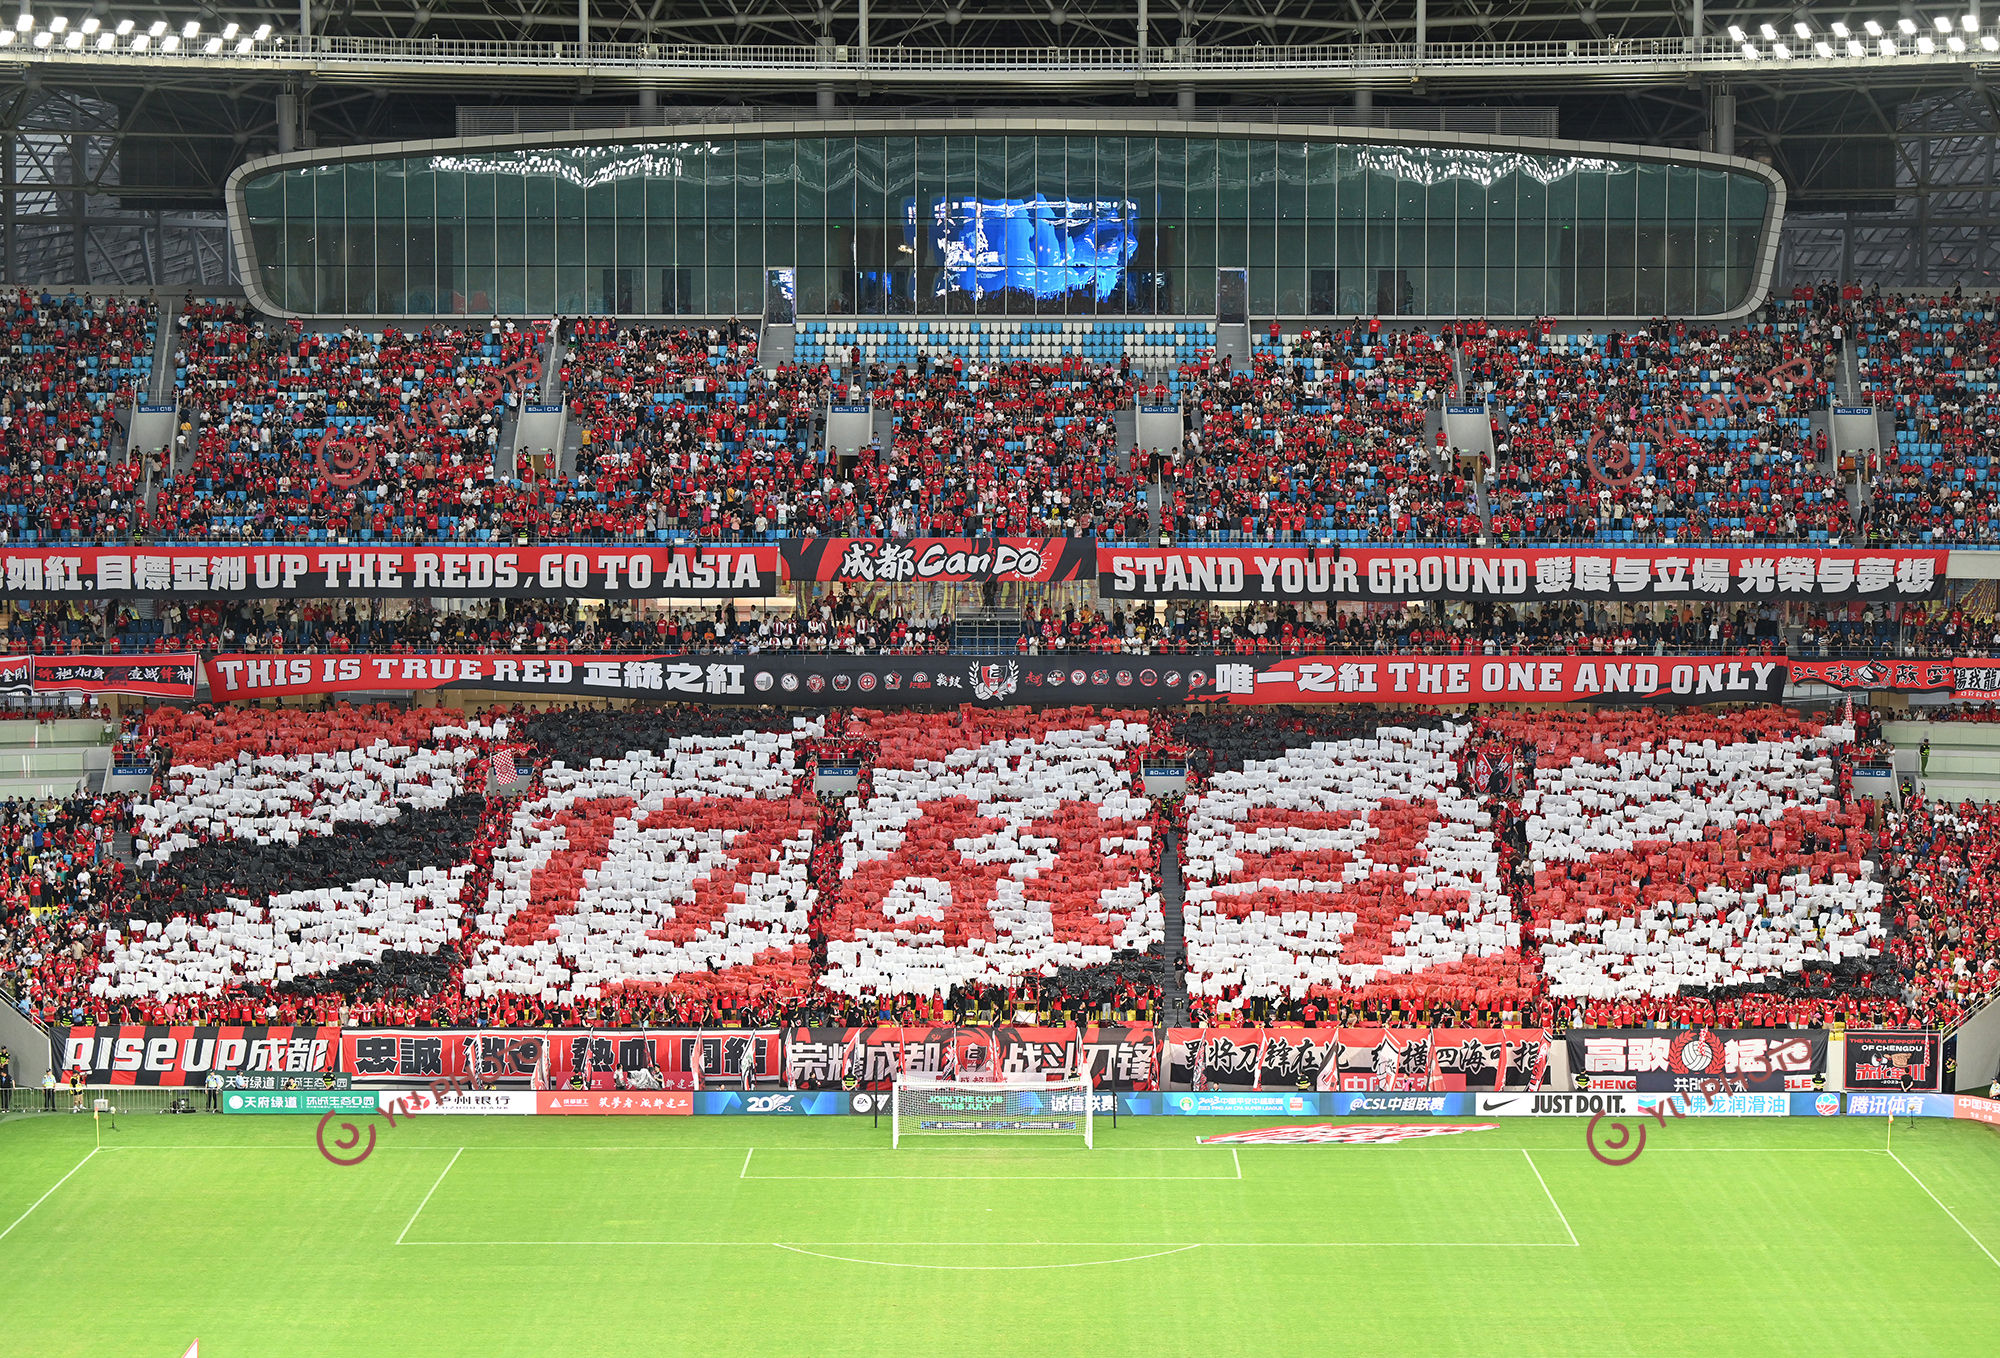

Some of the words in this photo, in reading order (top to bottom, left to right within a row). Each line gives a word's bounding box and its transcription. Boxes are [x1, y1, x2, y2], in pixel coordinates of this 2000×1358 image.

[0, 554, 247, 592] 如紅,目標亞洲
[254, 553, 308, 590] UP
[318, 553, 402, 589] THE
[539, 554, 589, 589] GO
[598, 554, 652, 589] TO
[663, 554, 760, 589] ASIA
[1113, 555, 1244, 593] STAND
[1254, 556, 1360, 593] YOUR
[1367, 556, 1527, 594] GROUND
[216, 659, 311, 691] THIS
[322, 659, 361, 682] IS
[372, 658, 482, 680] TRUE
[492, 659, 573, 684] RED
[583, 661, 745, 695] 正統之紅
[1215, 662, 1378, 695] 唯一之紅
[1387, 662, 1470, 693] THE
[1481, 662, 1563, 692] ONE
[1573, 662, 1659, 693] AND
[1670, 661, 1776, 695] ONLY
[355, 1037, 442, 1074] 忠誠
[1584, 1037, 1671, 1073] 高歌
[244, 1096, 298, 1108] 天府绿道
[747, 1096, 774, 1112] 20
[1531, 1095, 1573, 1113] JUST
[1576, 1095, 1603, 1113] DO
[1606, 1095, 1626, 1113] IT.
[1849, 1096, 1926, 1114] 腾讯体育
